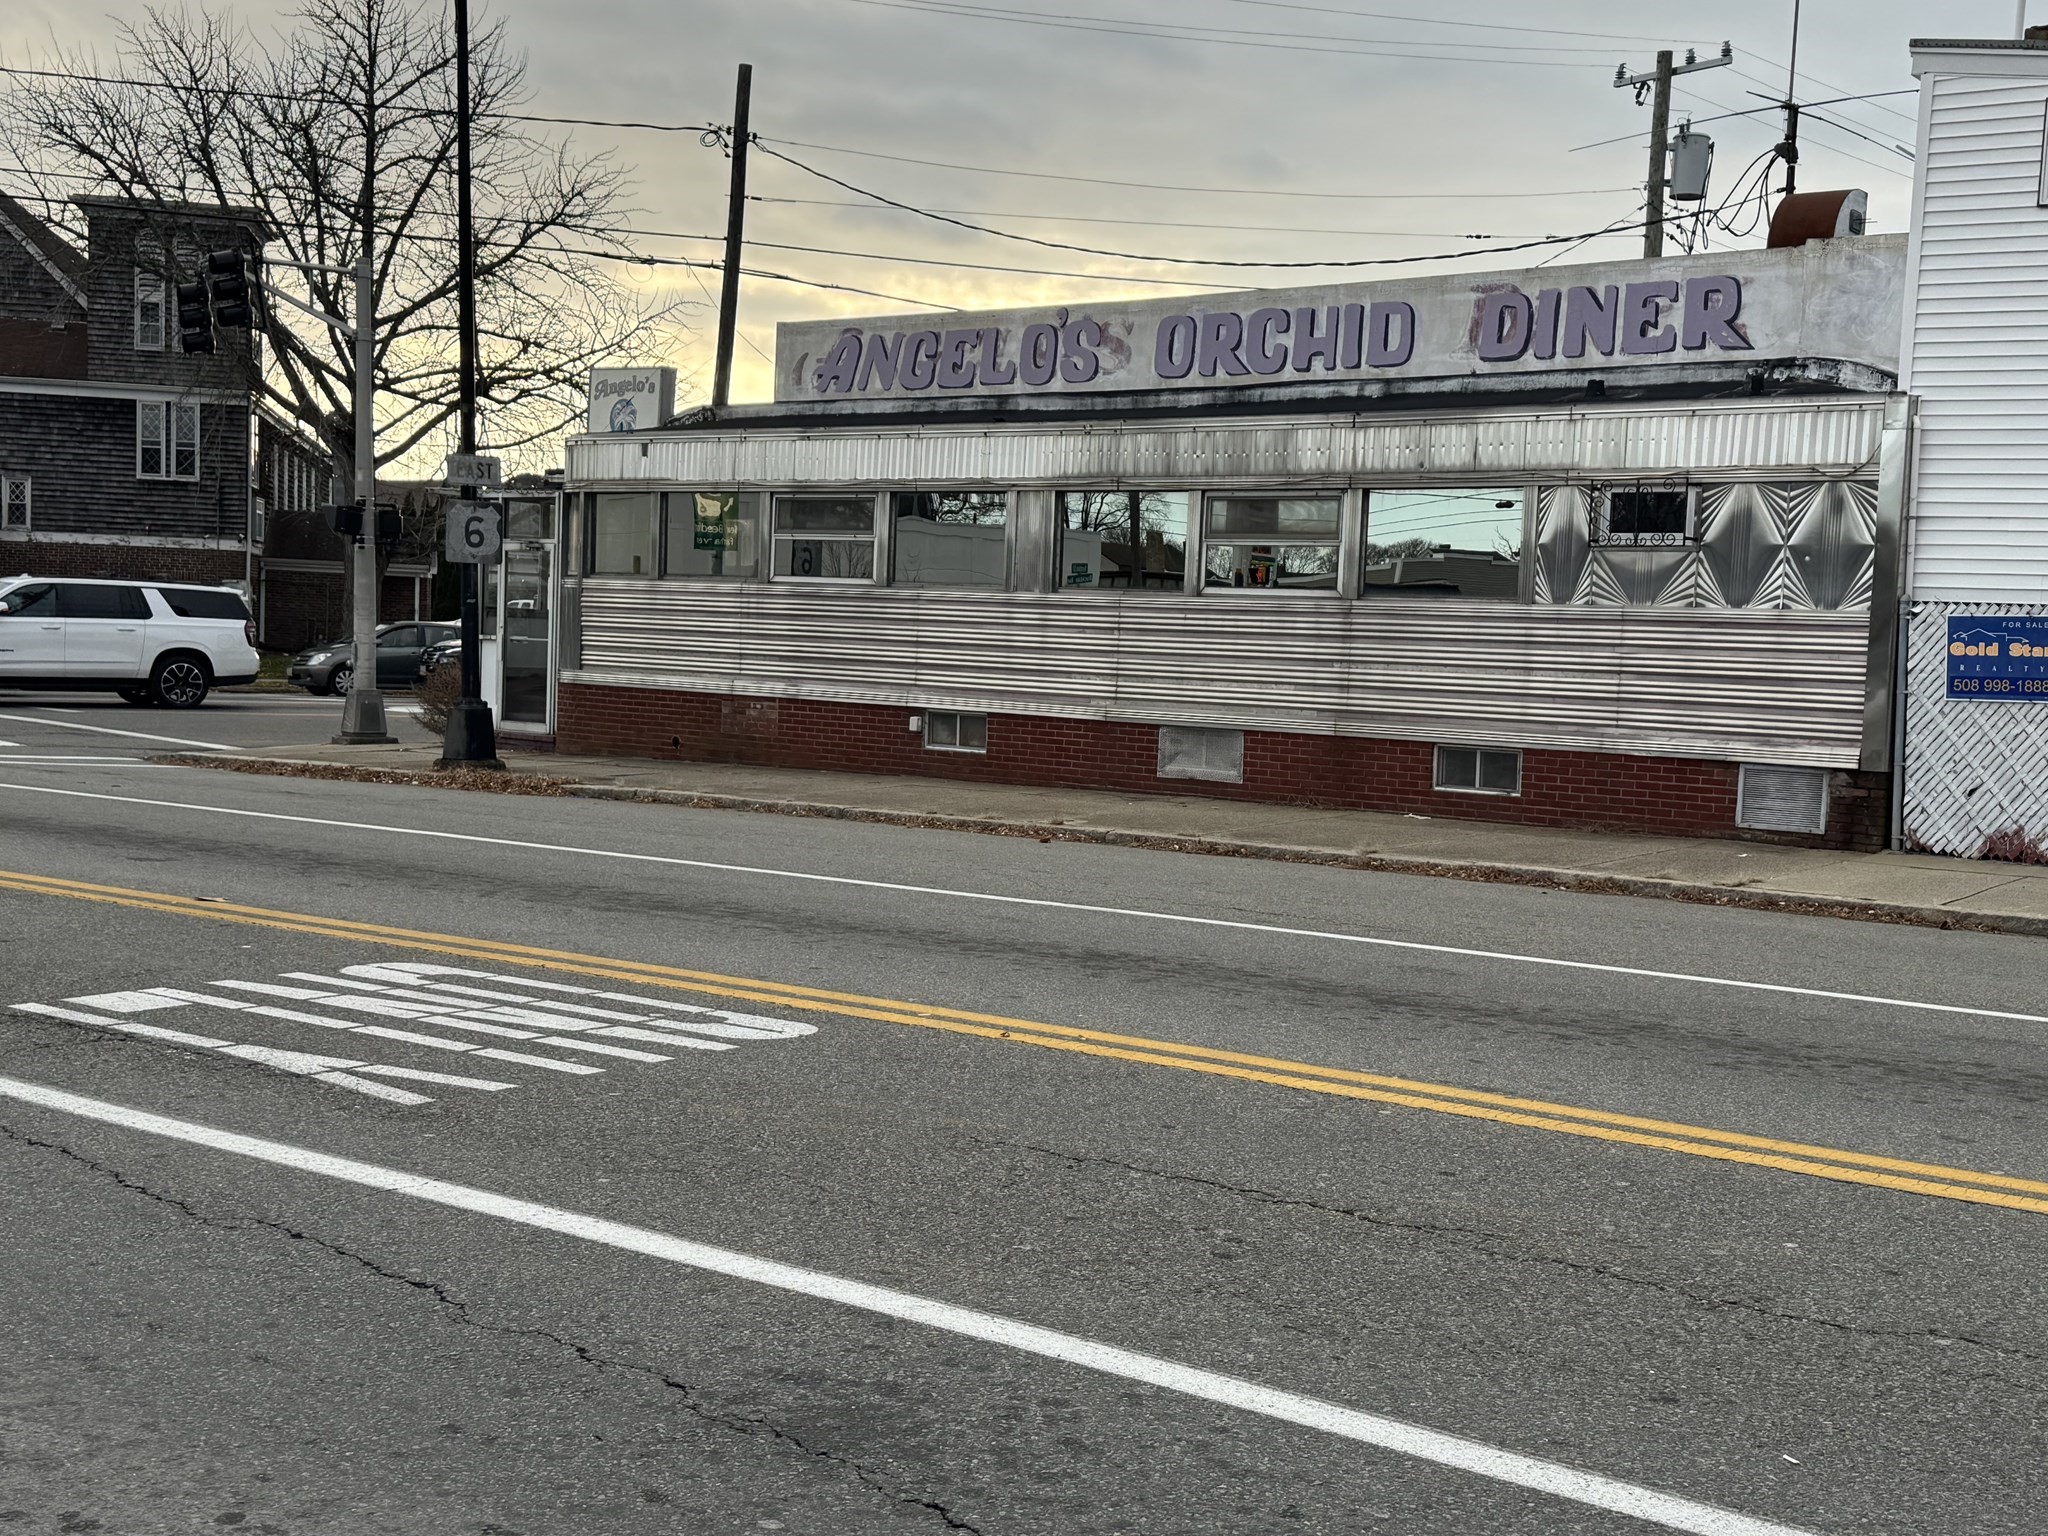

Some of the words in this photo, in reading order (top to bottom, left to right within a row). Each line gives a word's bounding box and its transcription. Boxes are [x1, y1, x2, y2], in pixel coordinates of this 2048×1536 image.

[815, 307, 1102, 393] ANGELO'S
[1154, 301, 1416, 379] ORCHID
[1478, 275, 1755, 362] DINER
[594, 374, 656, 400] Angelo's
[456, 461, 493, 480] EAST
[464, 516, 485, 548] 6
[1949, 641, 1999, 657] Gold
[1959, 665, 2045, 673] REALTY
[1953, 679, 1979, 692] 508
[1984, 679, 2048, 693] 998-1888
[7, 962, 820, 1106] ONLY
